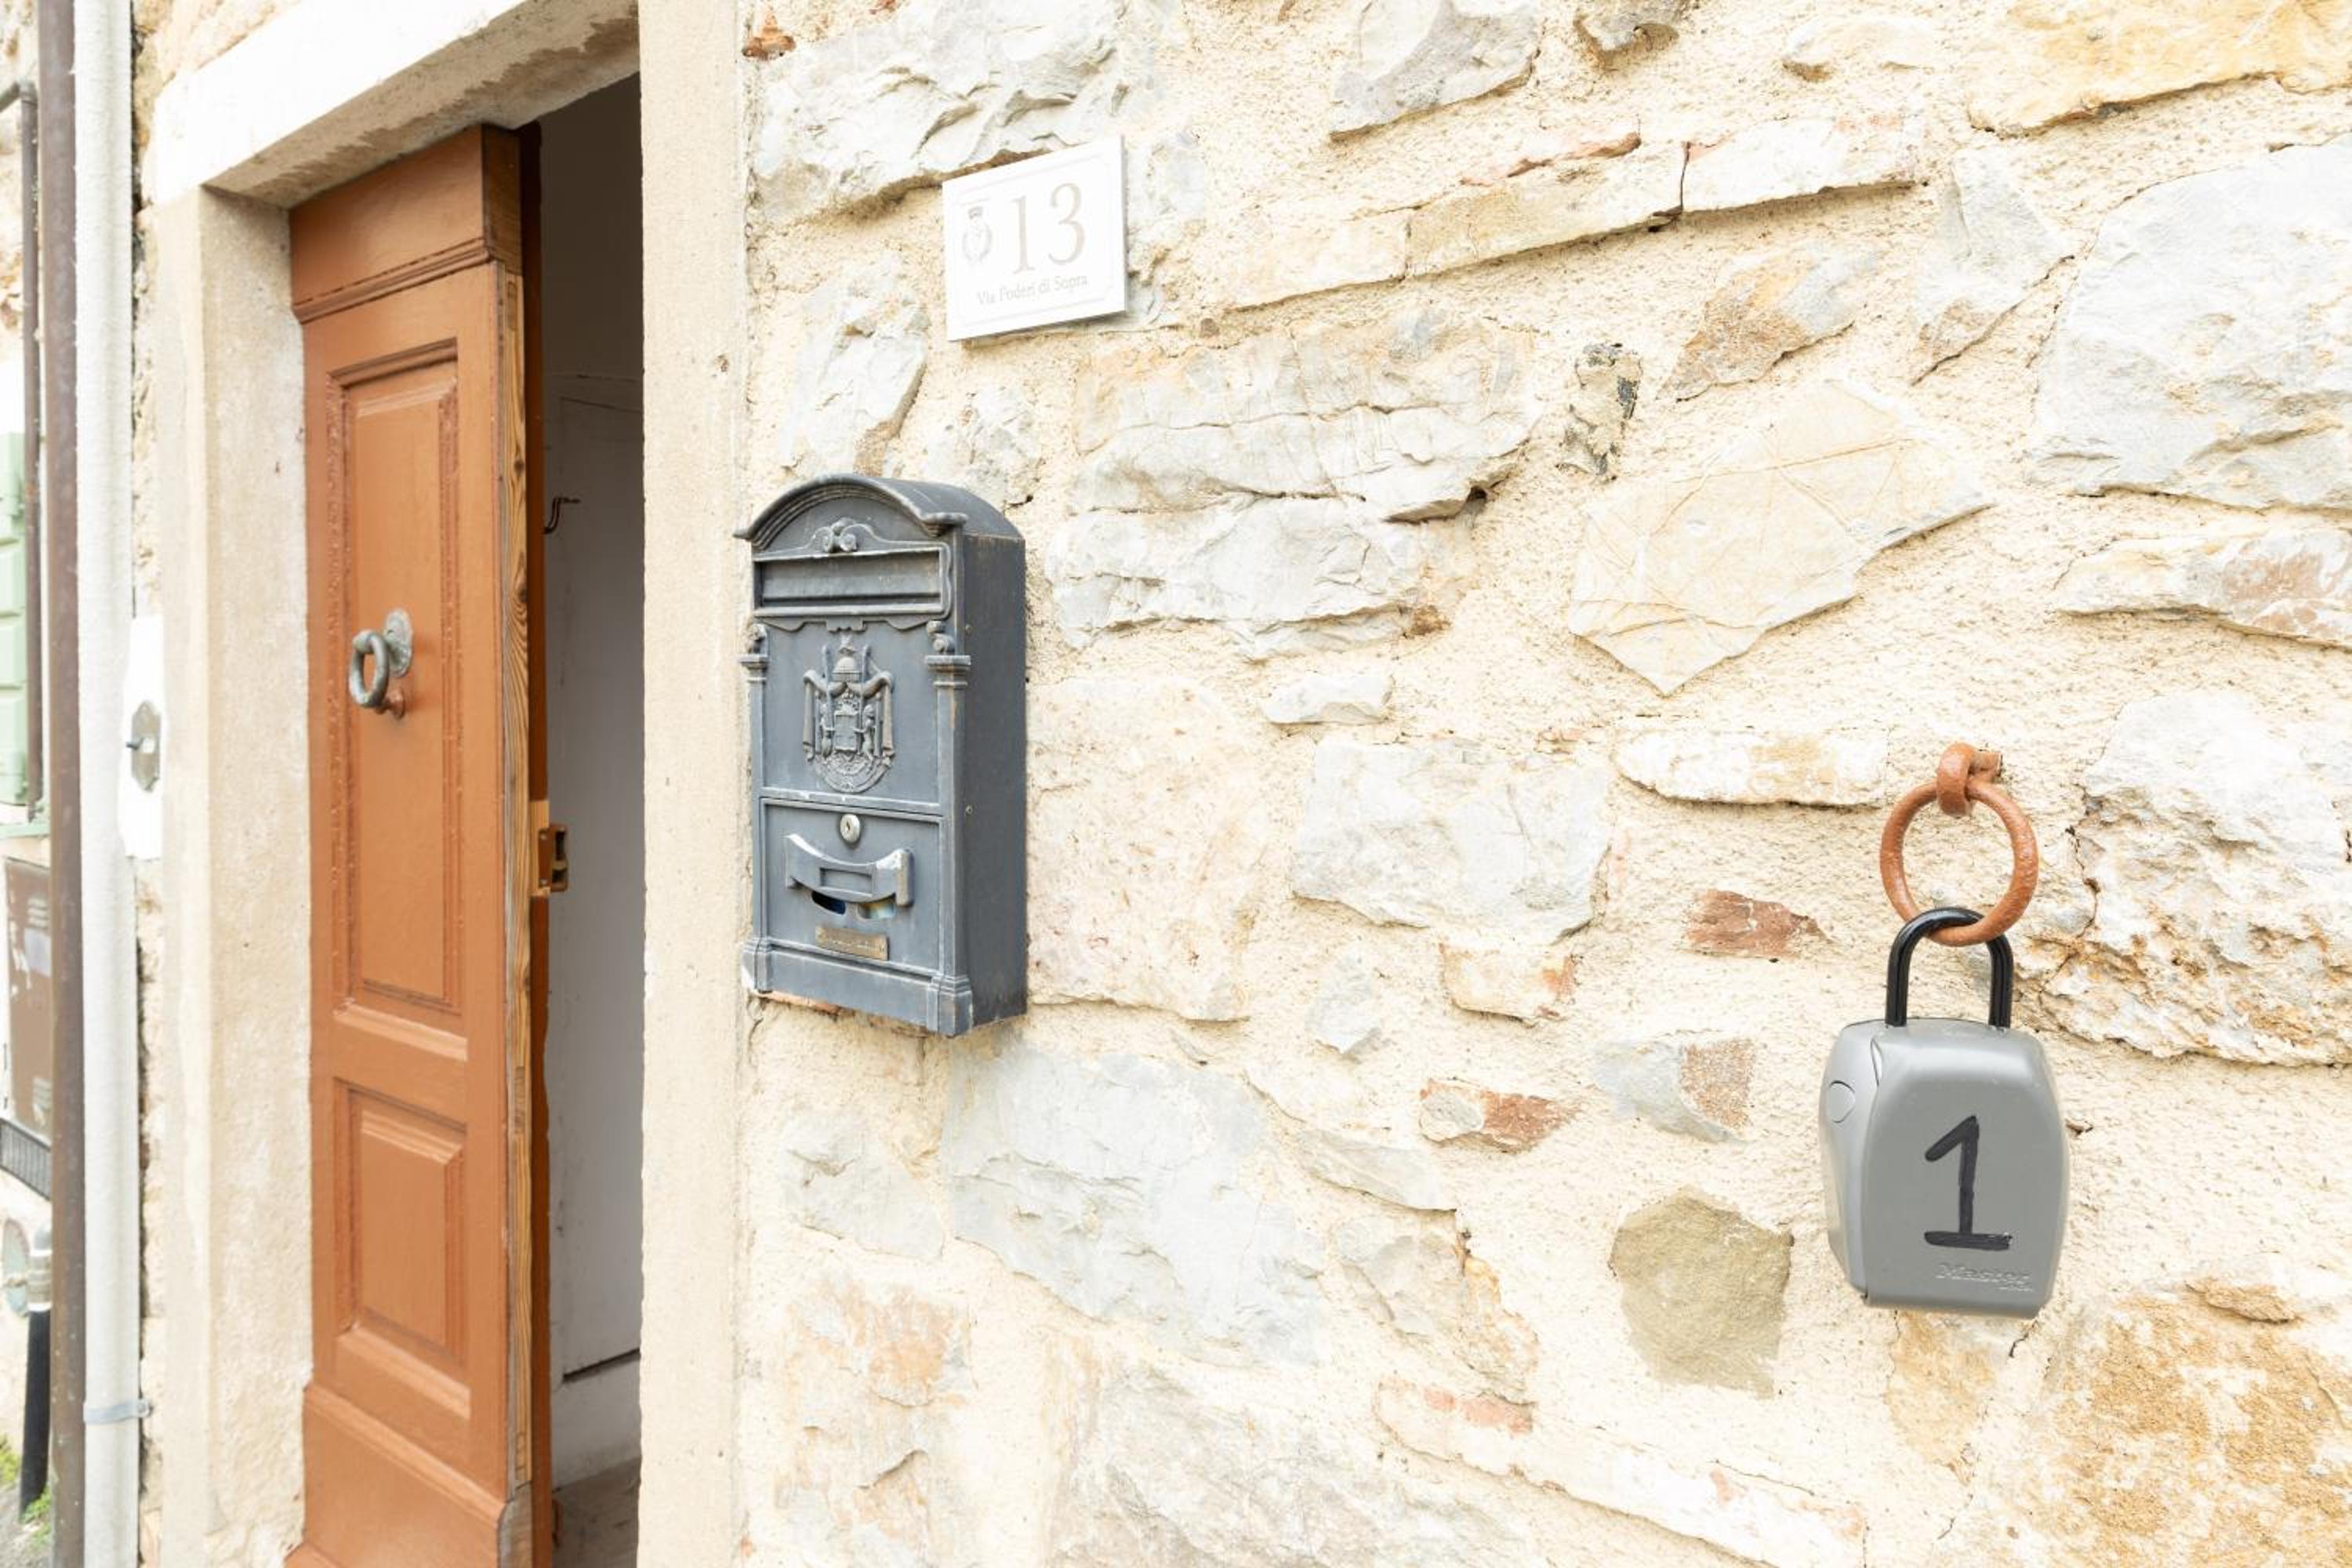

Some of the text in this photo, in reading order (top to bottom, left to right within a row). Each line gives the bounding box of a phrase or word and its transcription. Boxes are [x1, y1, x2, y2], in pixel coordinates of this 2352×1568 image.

[1010, 183, 1085, 274] 13
[977, 291, 995, 304] Via
[1039, 278, 1050, 293] di
[1054, 275, 1087, 292] Sopra
[1924, 1115, 2013, 1251] 1
